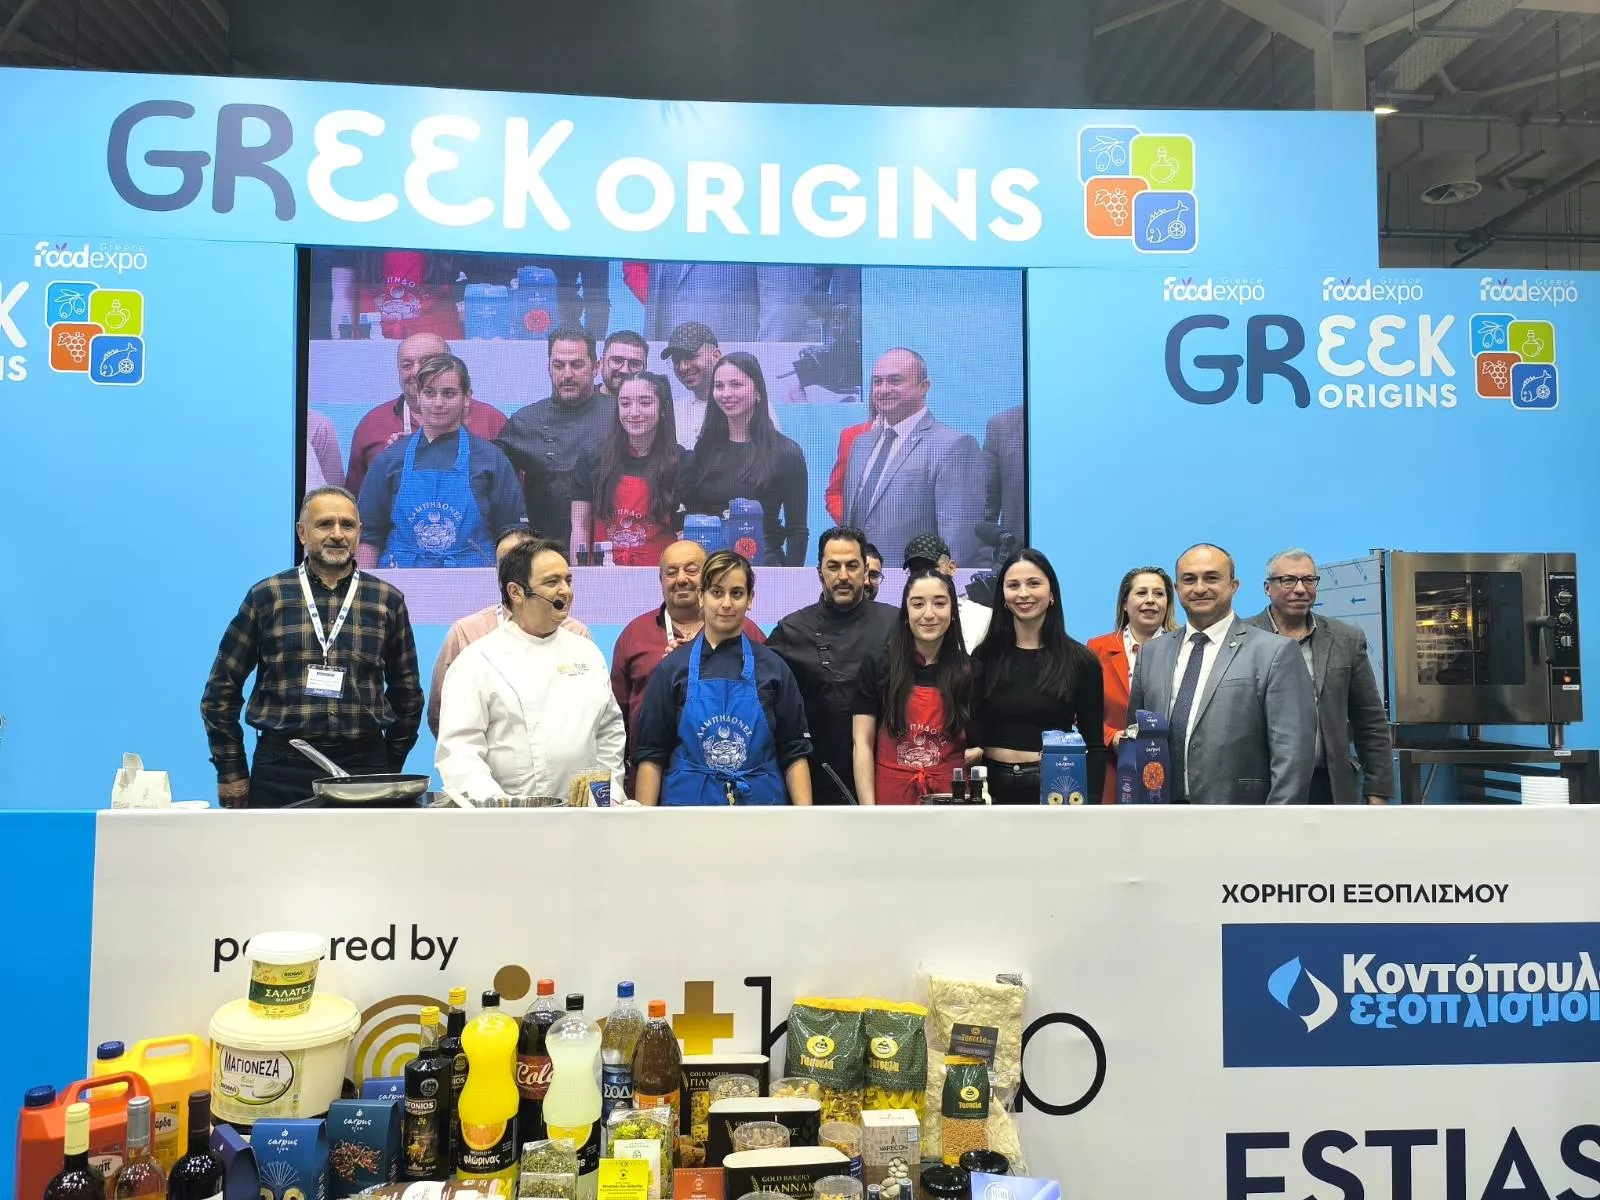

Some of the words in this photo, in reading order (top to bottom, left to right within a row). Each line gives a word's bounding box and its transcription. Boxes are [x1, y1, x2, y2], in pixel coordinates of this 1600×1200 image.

[596, 157, 1042, 242] ORIGINS
[1318, 383, 1457, 408] ORIGINS
[697, 714, 753, 738] ΛΑΜΠΗΔΟΝΕΣ
[1221, 883, 1335, 904] ΧΟΡΗΓΟΙ
[1344, 883, 1509, 904] ΕΞΟΠΛΙΣΜΟΥ
[213, 924, 395, 972] pred
[411, 924, 459, 970] by
[1343, 952, 1600, 994] Κοντόπουλ
[264, 984, 312, 998] ΣΑΛΑΤΕΣ
[223, 1051, 280, 1078] ΜΑΓΙΟΝΕΖΑ
[604, 1083, 633, 1099] ΣΟΔ
[343, 1118, 372, 1128] carpus
[268, 1138, 298, 1149] carpus
